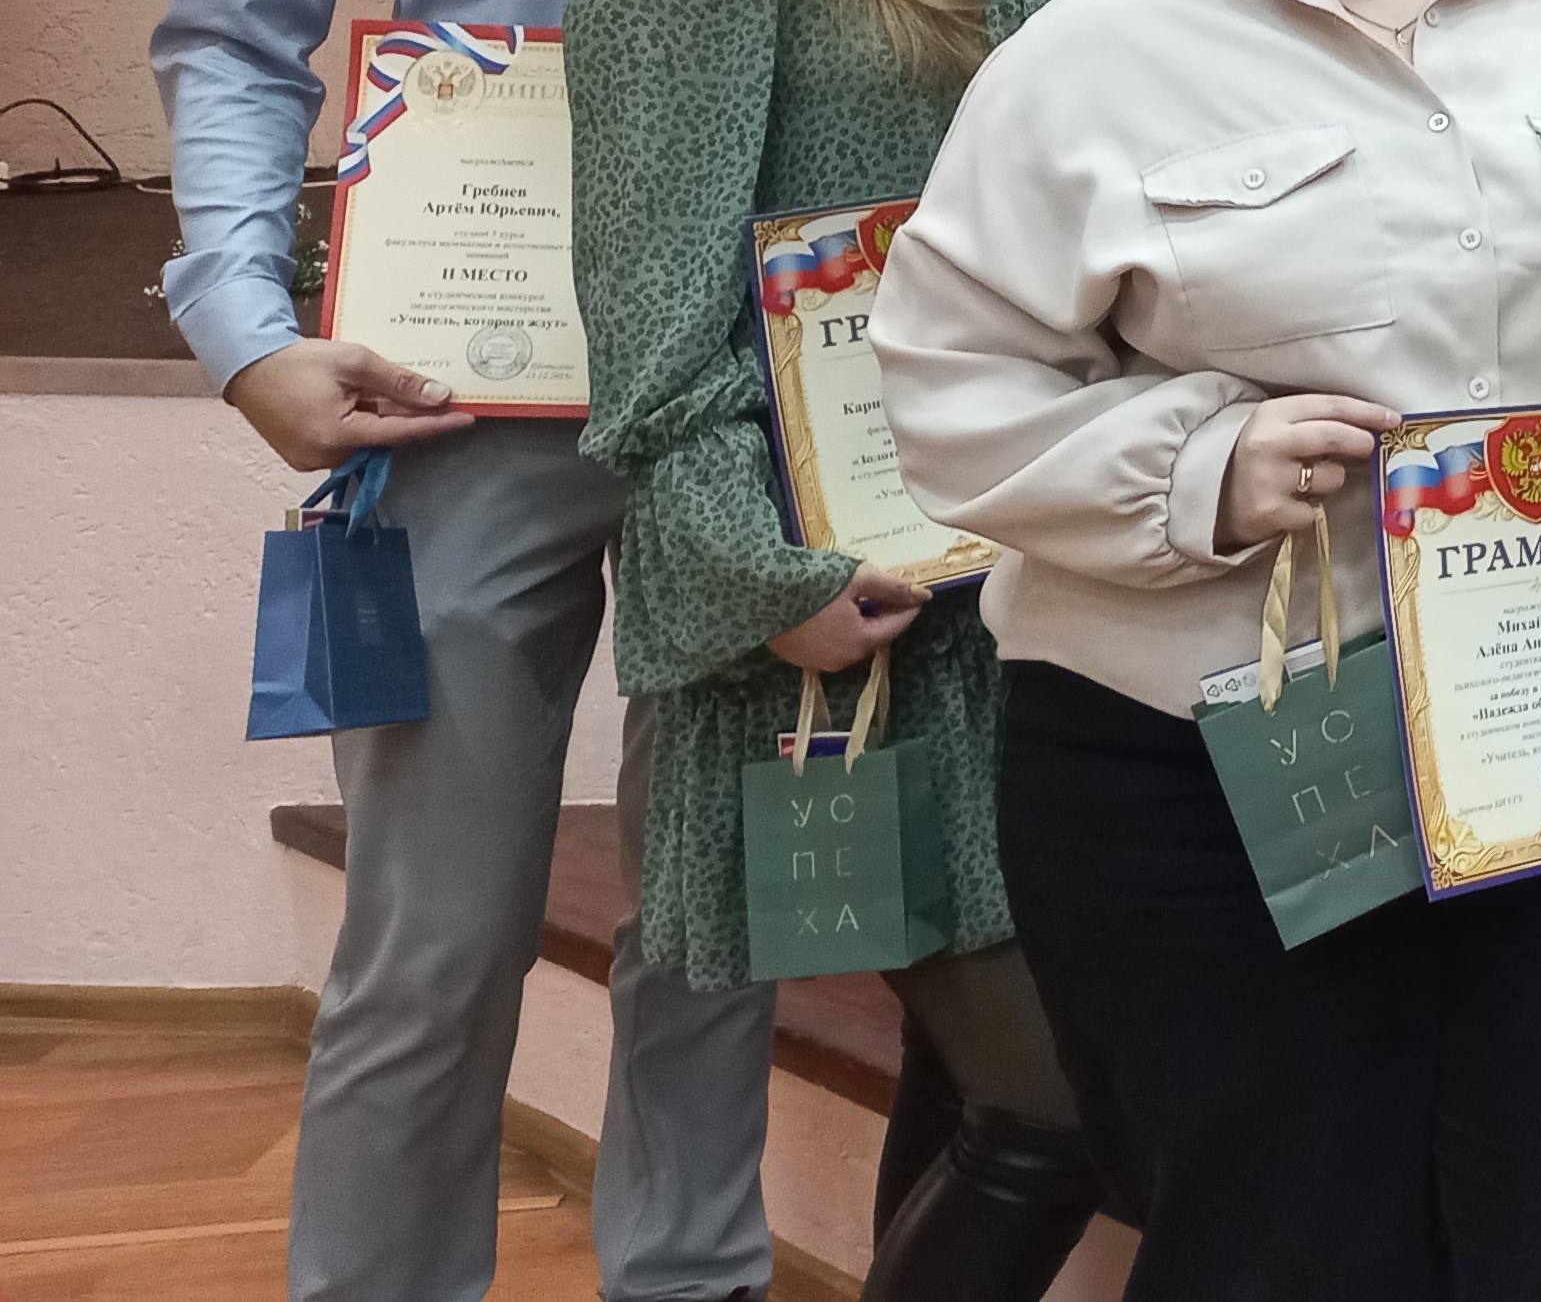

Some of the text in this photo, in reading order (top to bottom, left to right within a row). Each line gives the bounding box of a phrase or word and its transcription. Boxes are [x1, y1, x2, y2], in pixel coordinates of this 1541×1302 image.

[487, 83, 565, 99] ДИПЛ
[462, 183, 527, 199] Гребнев
[423, 201, 561, 218] Артём Юрьевич,
[442, 268, 528, 283] II МЕСТО
[390, 313, 569, 330] «Учитель, которого ждут»
[843, 399, 882, 416] Кари
[1476, 641, 1518, 660] Алёна
